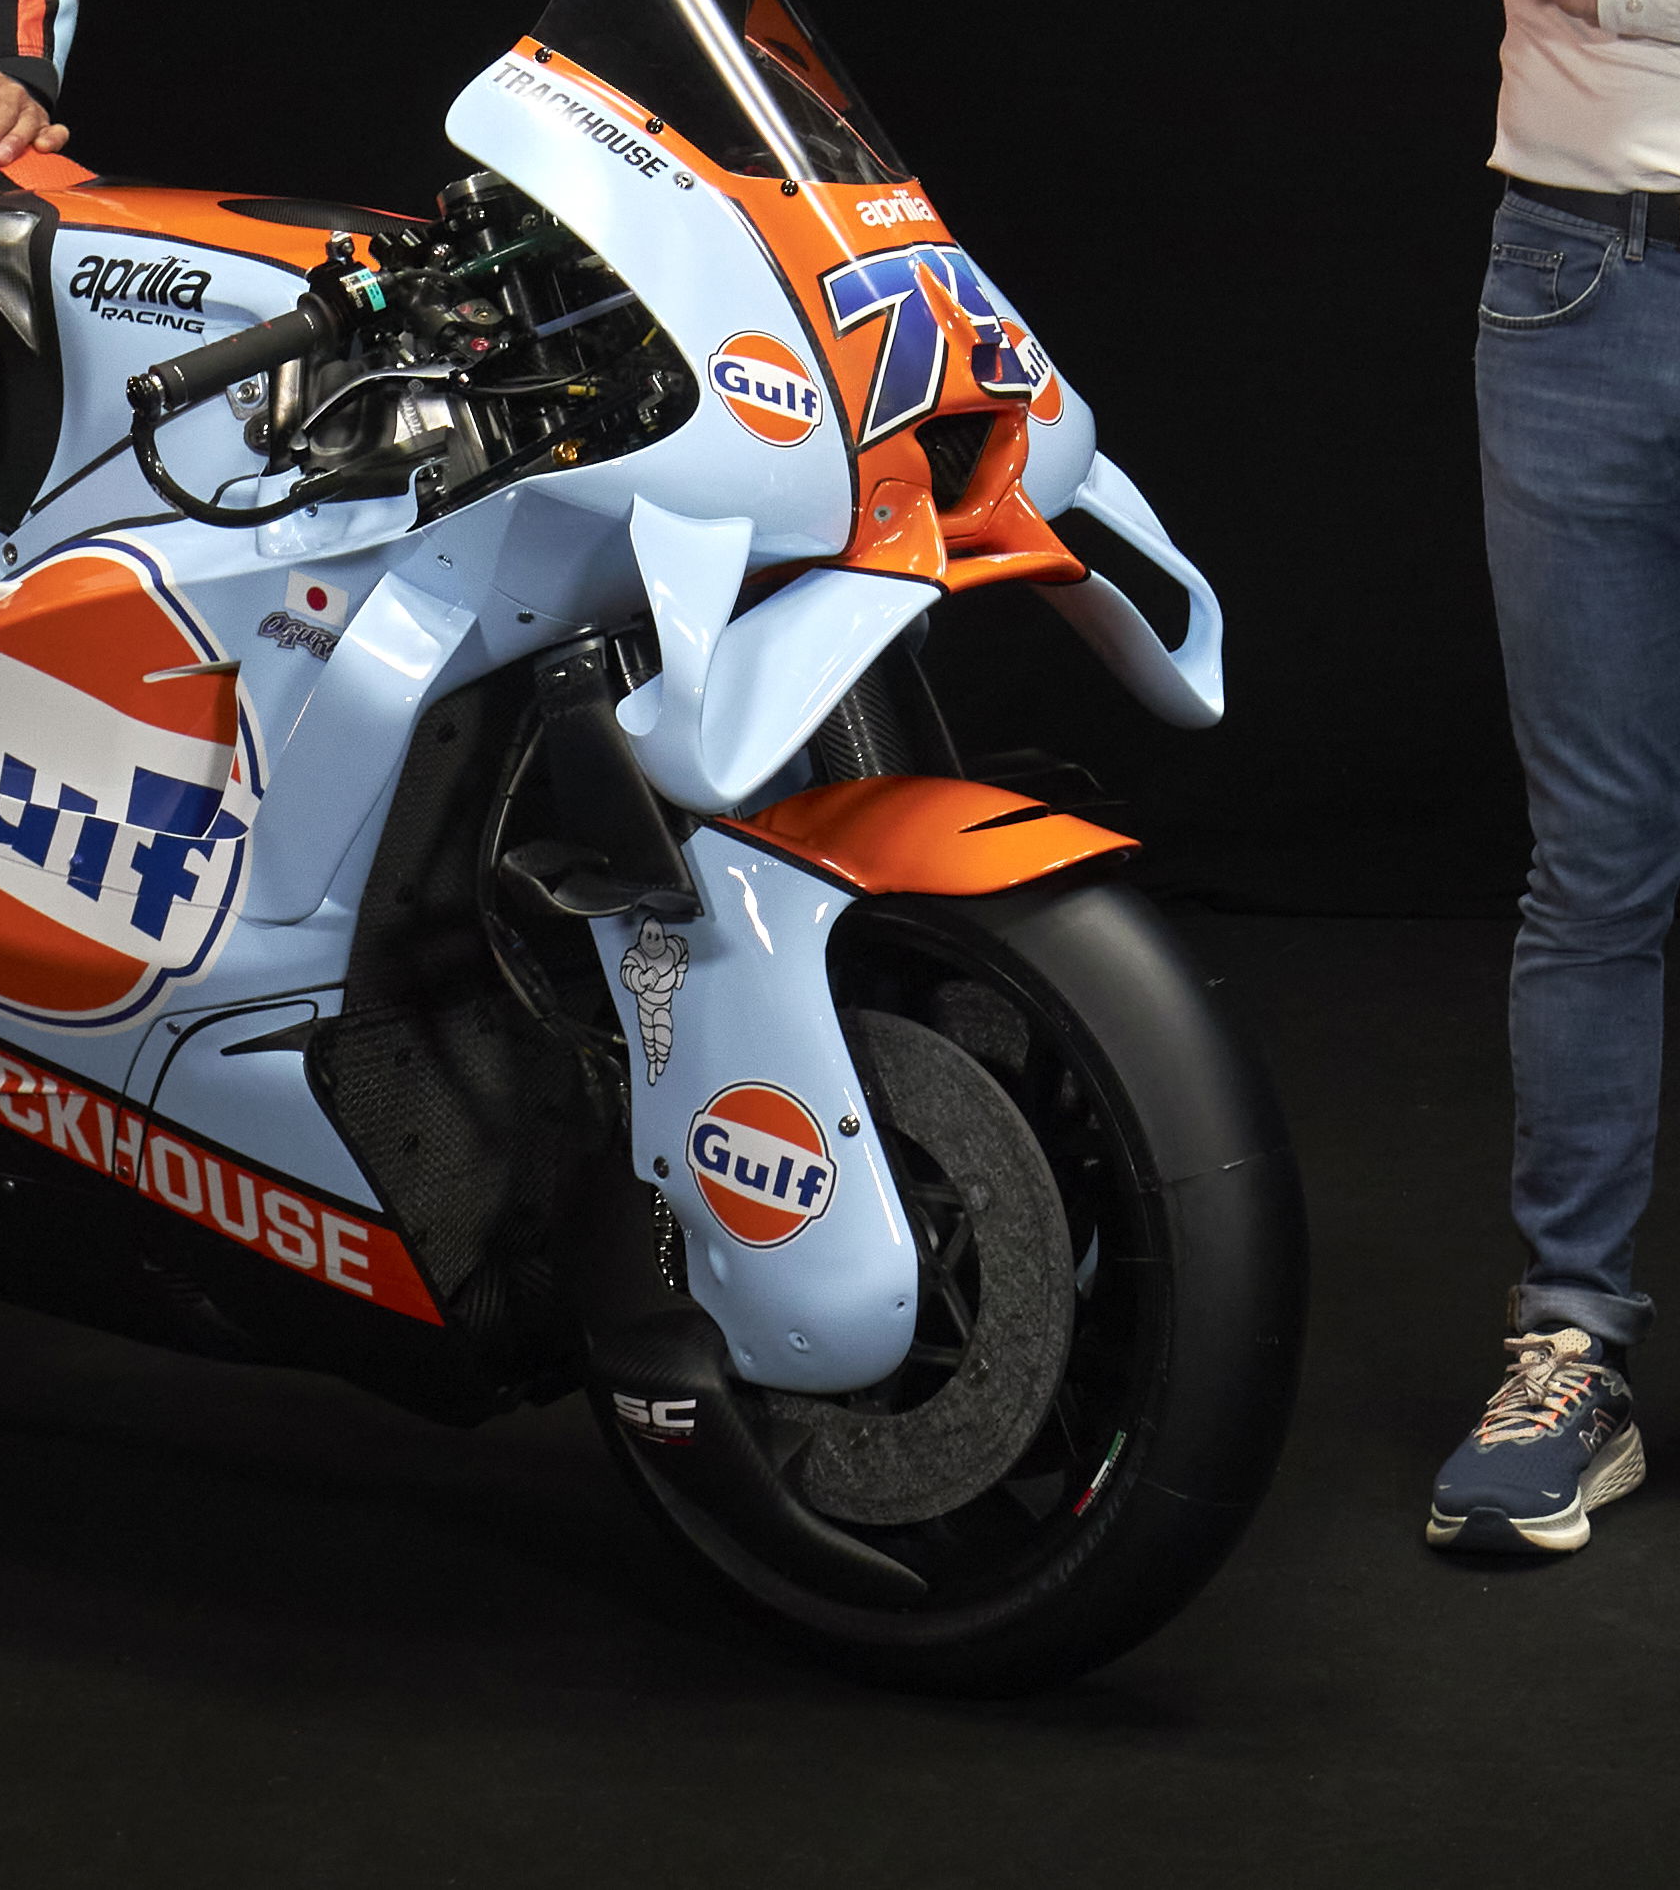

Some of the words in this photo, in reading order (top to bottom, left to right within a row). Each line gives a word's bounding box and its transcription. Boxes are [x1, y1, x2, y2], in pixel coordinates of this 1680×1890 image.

[492, 60, 669, 182] TRACKHOUSE
[856, 189, 937, 229] aprilia
[68, 254, 212, 313] aprilia
[100, 307, 205, 334] RACING
[712, 359, 820, 422] Gulf
[691, 1122, 829, 1210] Gulf
[612, 1391, 698, 1429] SC
